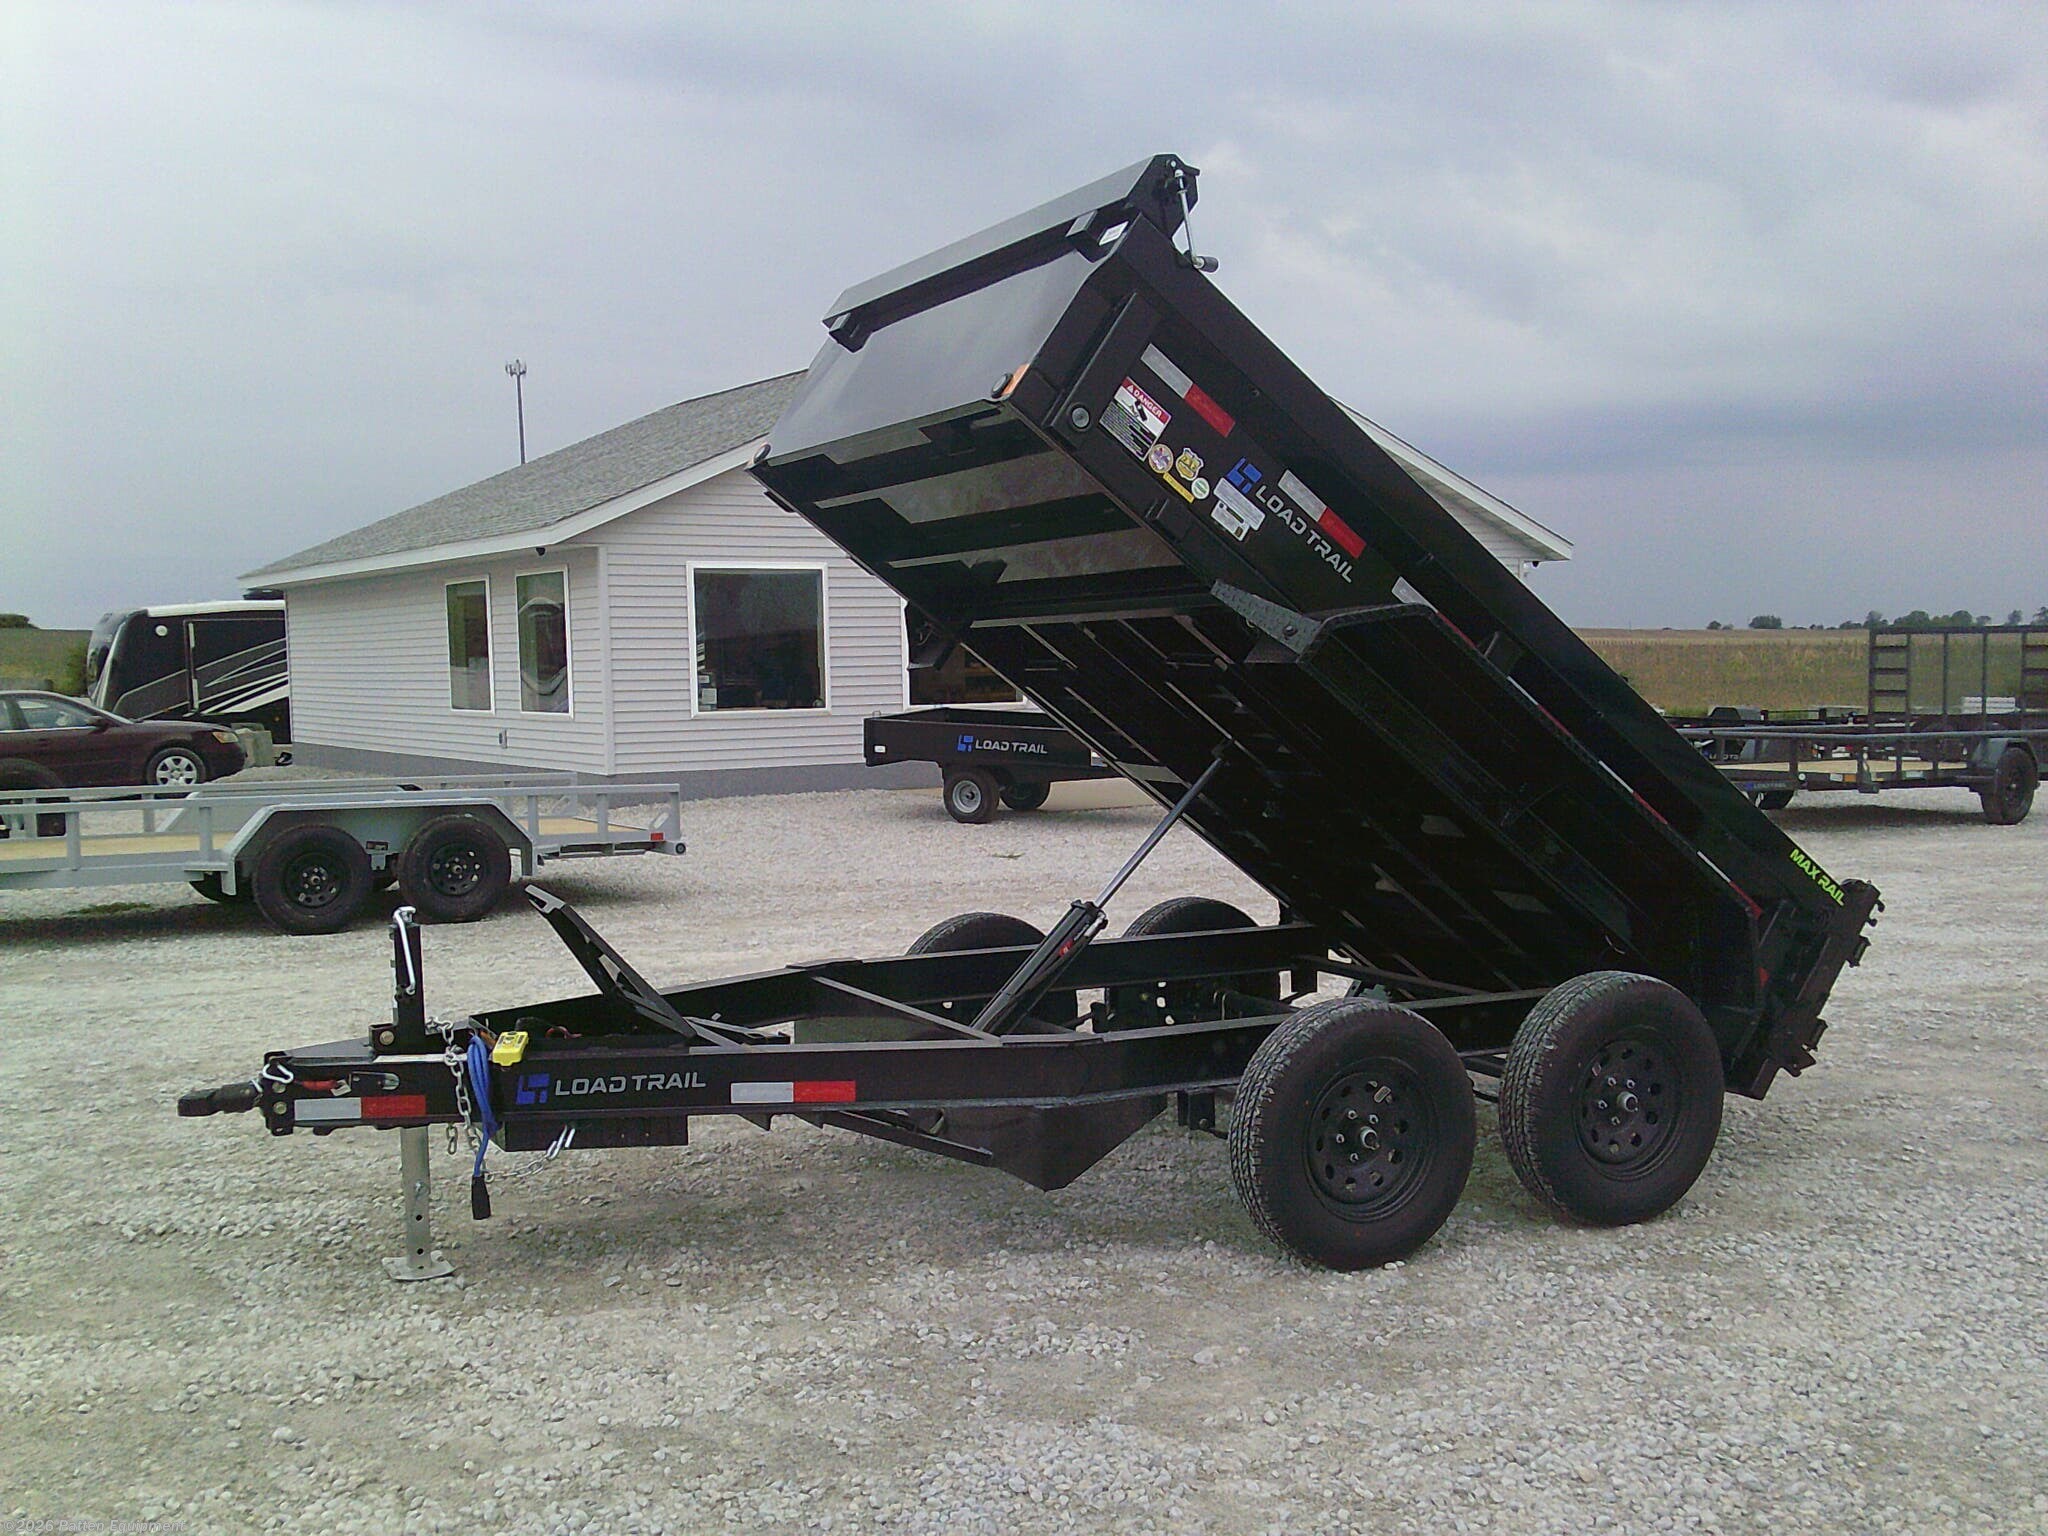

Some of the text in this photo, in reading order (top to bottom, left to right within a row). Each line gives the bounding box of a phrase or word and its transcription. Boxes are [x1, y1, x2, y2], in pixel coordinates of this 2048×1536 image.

[1133, 390, 1163, 418] DANGER
[1255, 485, 1308, 535] LOAD
[1306, 529, 1353, 584] TRAIL
[975, 739, 1048, 754] LOAD TRAIL
[1790, 849, 1846, 906] MAX RAIL
[555, 1071, 707, 1096] LOAD TRAIL
